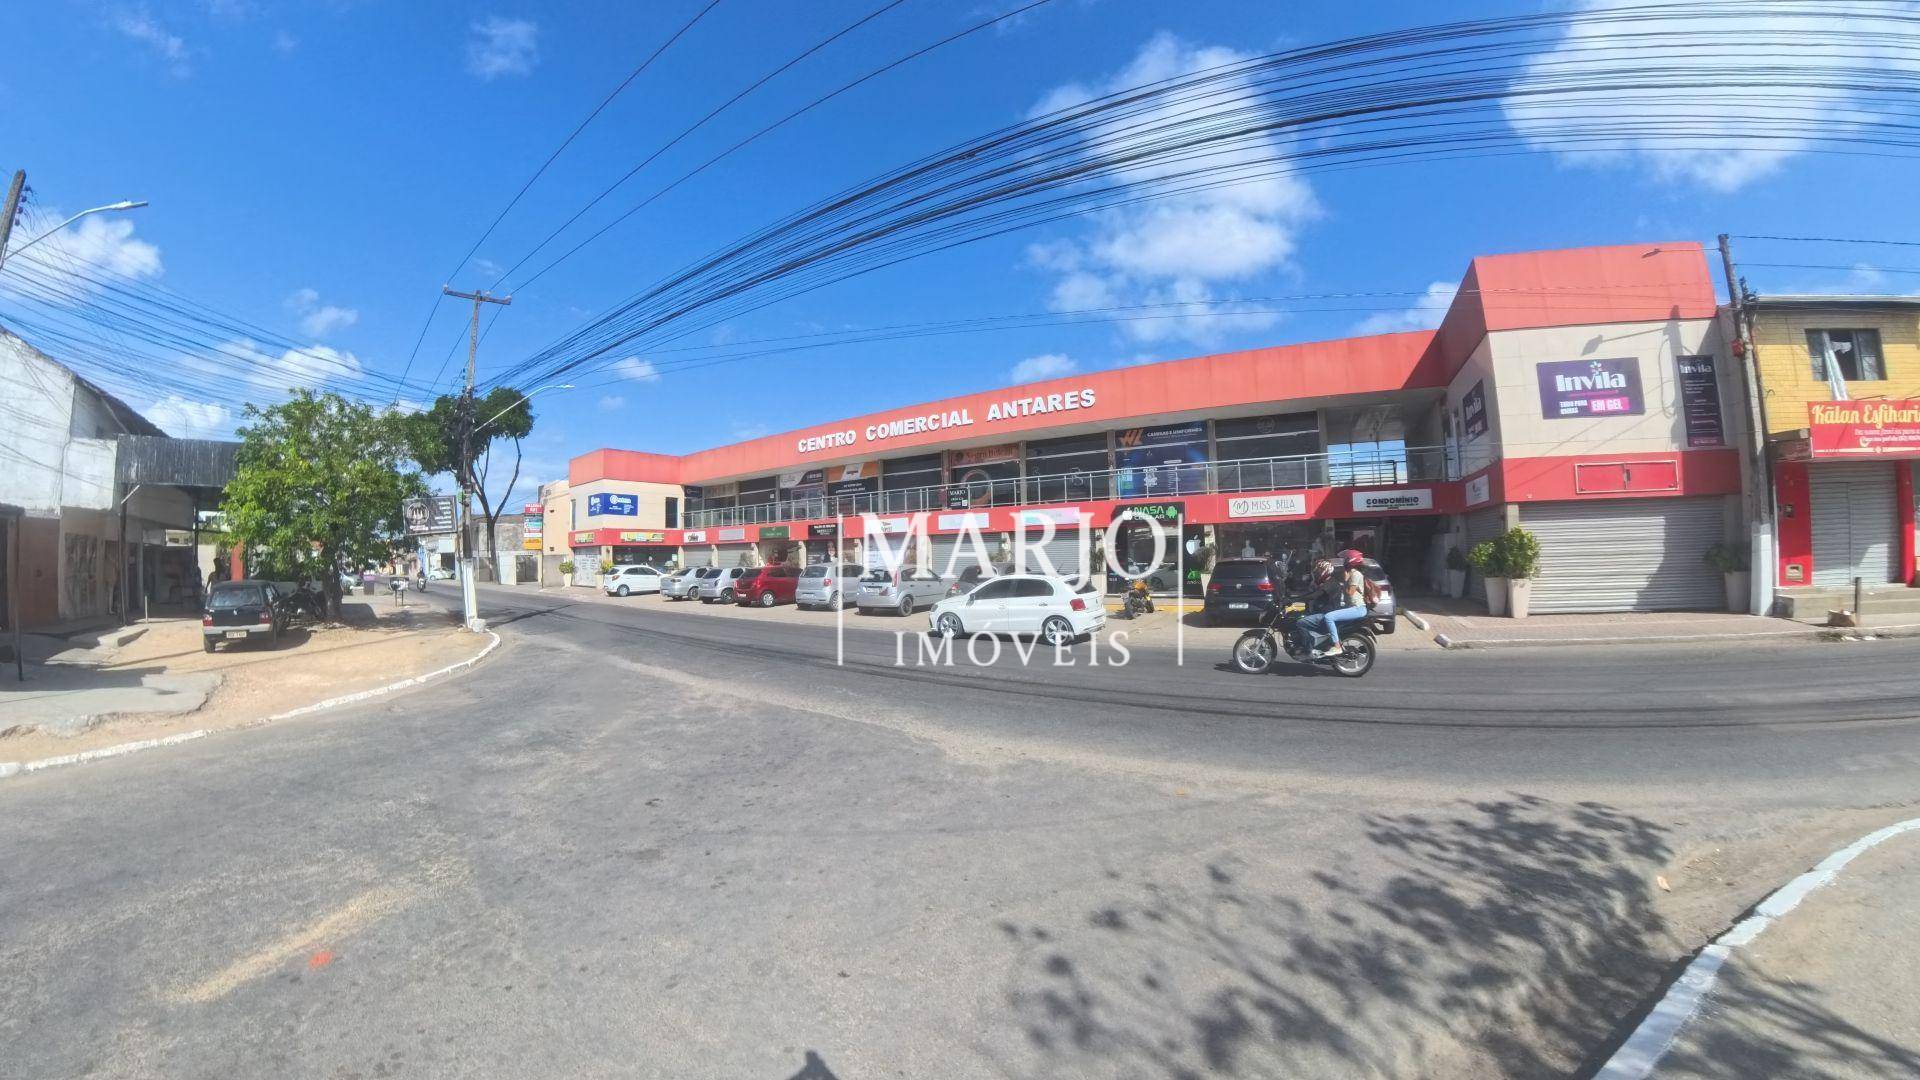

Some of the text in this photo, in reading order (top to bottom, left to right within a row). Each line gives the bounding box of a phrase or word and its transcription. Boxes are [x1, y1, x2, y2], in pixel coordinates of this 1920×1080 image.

[1680, 364, 1713, 374] Invila
[1556, 371, 1627, 392] Invila
[1592, 398, 1623, 411] EM GEL
[798, 388, 1096, 453] CENTRO COMERCIAL ANTARES
[1251, 500, 1271, 511] MISS
[1276, 498, 1295, 509] BELLA
[1365, 495, 1420, 505] CONDOMÍNIO
[1133, 505, 1164, 514] NASA
